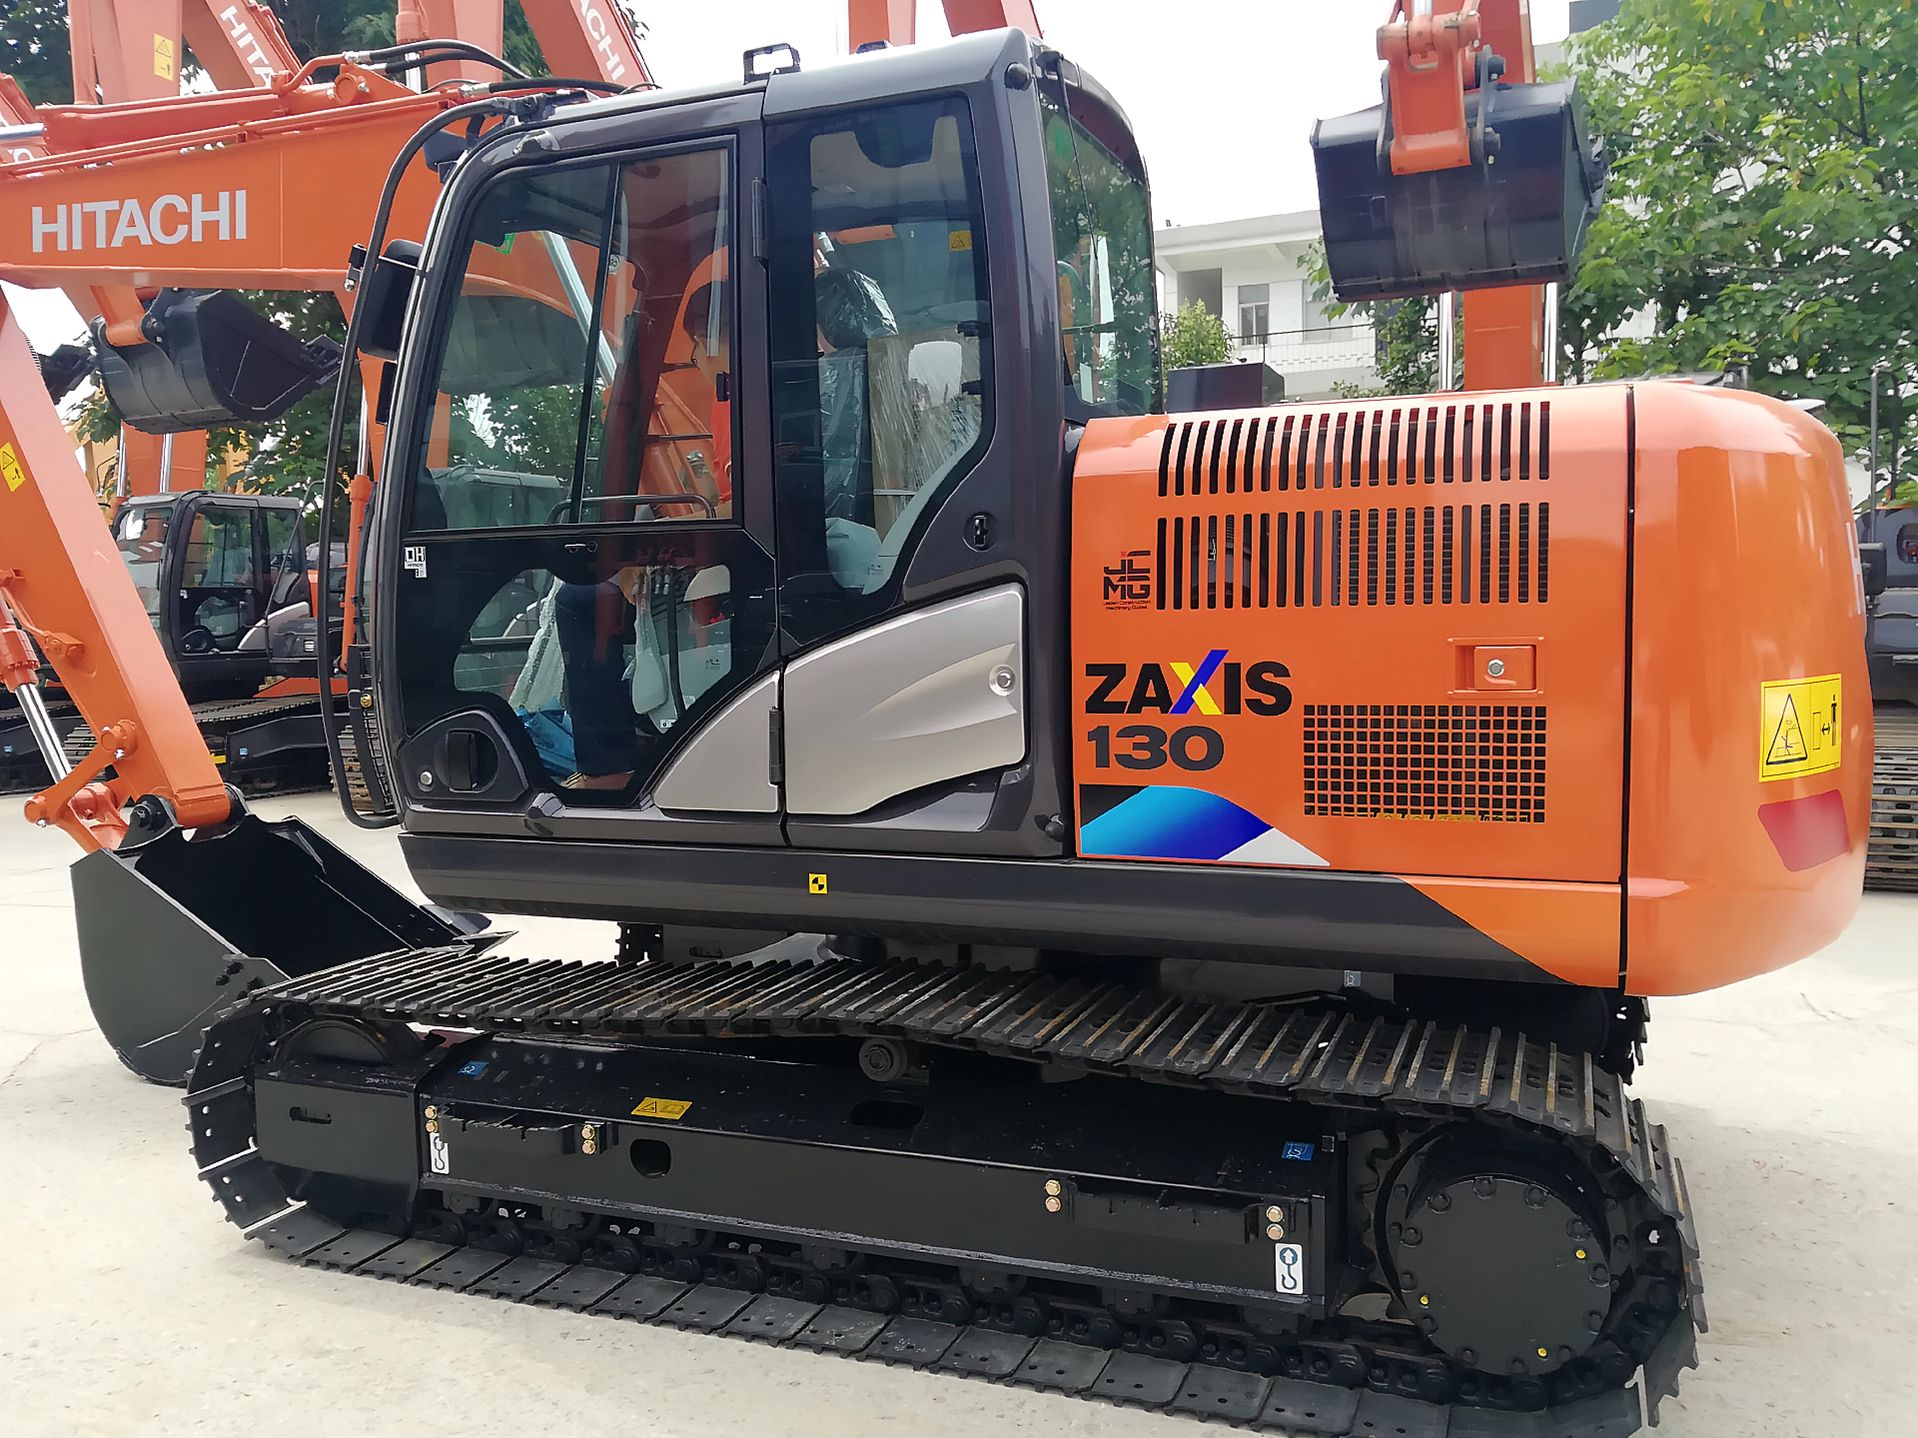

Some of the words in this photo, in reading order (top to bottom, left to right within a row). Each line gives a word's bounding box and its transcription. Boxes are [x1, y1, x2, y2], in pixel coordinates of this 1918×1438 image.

[31, 189, 247, 253] HITACHI
[1085, 649, 1293, 716] ZAXIS
[1087, 725, 1225, 772] 130
